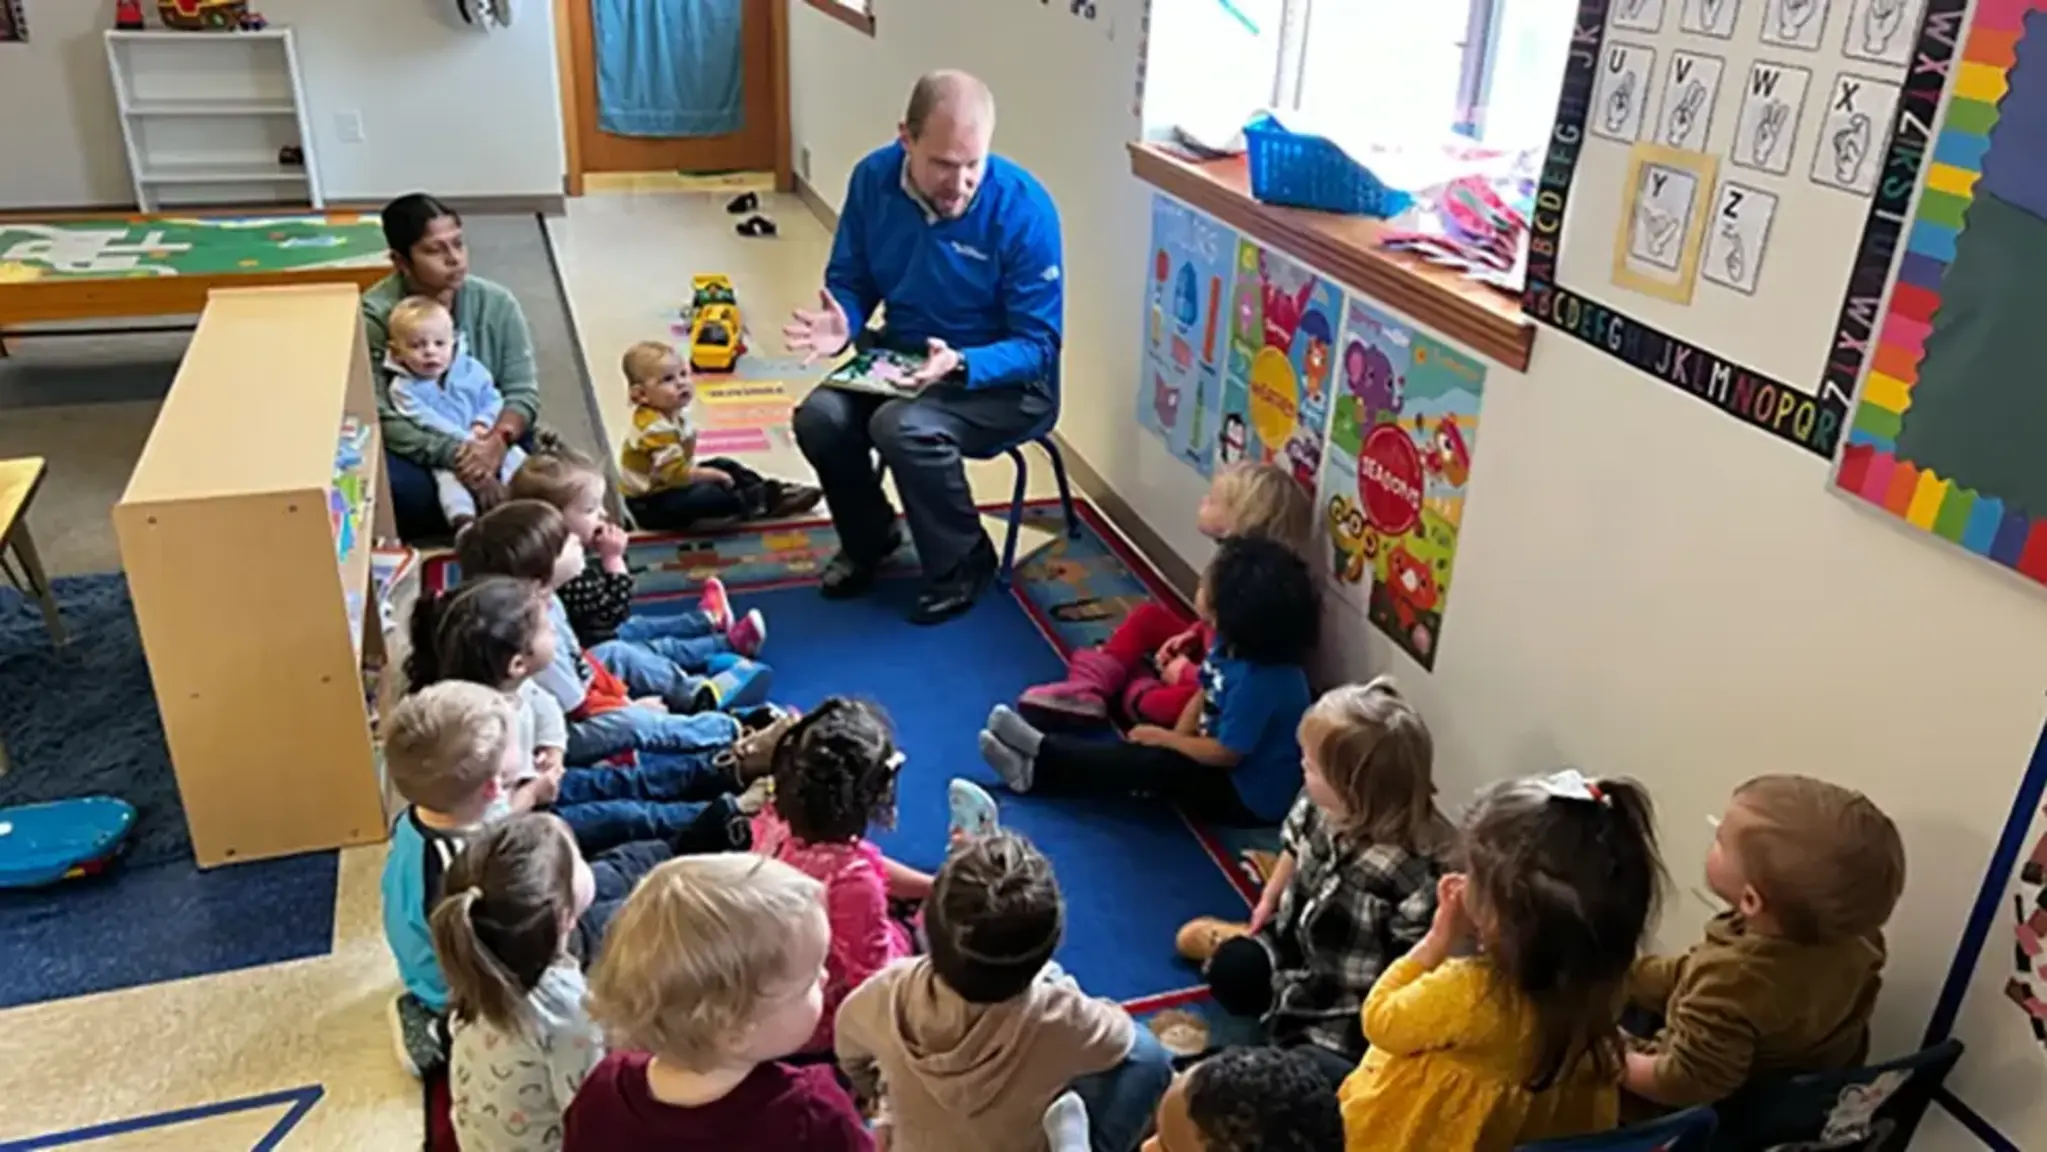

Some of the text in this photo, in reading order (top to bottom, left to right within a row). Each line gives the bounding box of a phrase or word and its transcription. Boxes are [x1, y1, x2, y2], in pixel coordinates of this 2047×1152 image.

[1609, 49, 1627, 74] U
[1675, 57, 1693, 84] V
[1752, 67, 1780, 98] W
[1834, 81, 1860, 112] X
[1651, 172, 1668, 198] Y
[1722, 190, 1744, 218] Z
